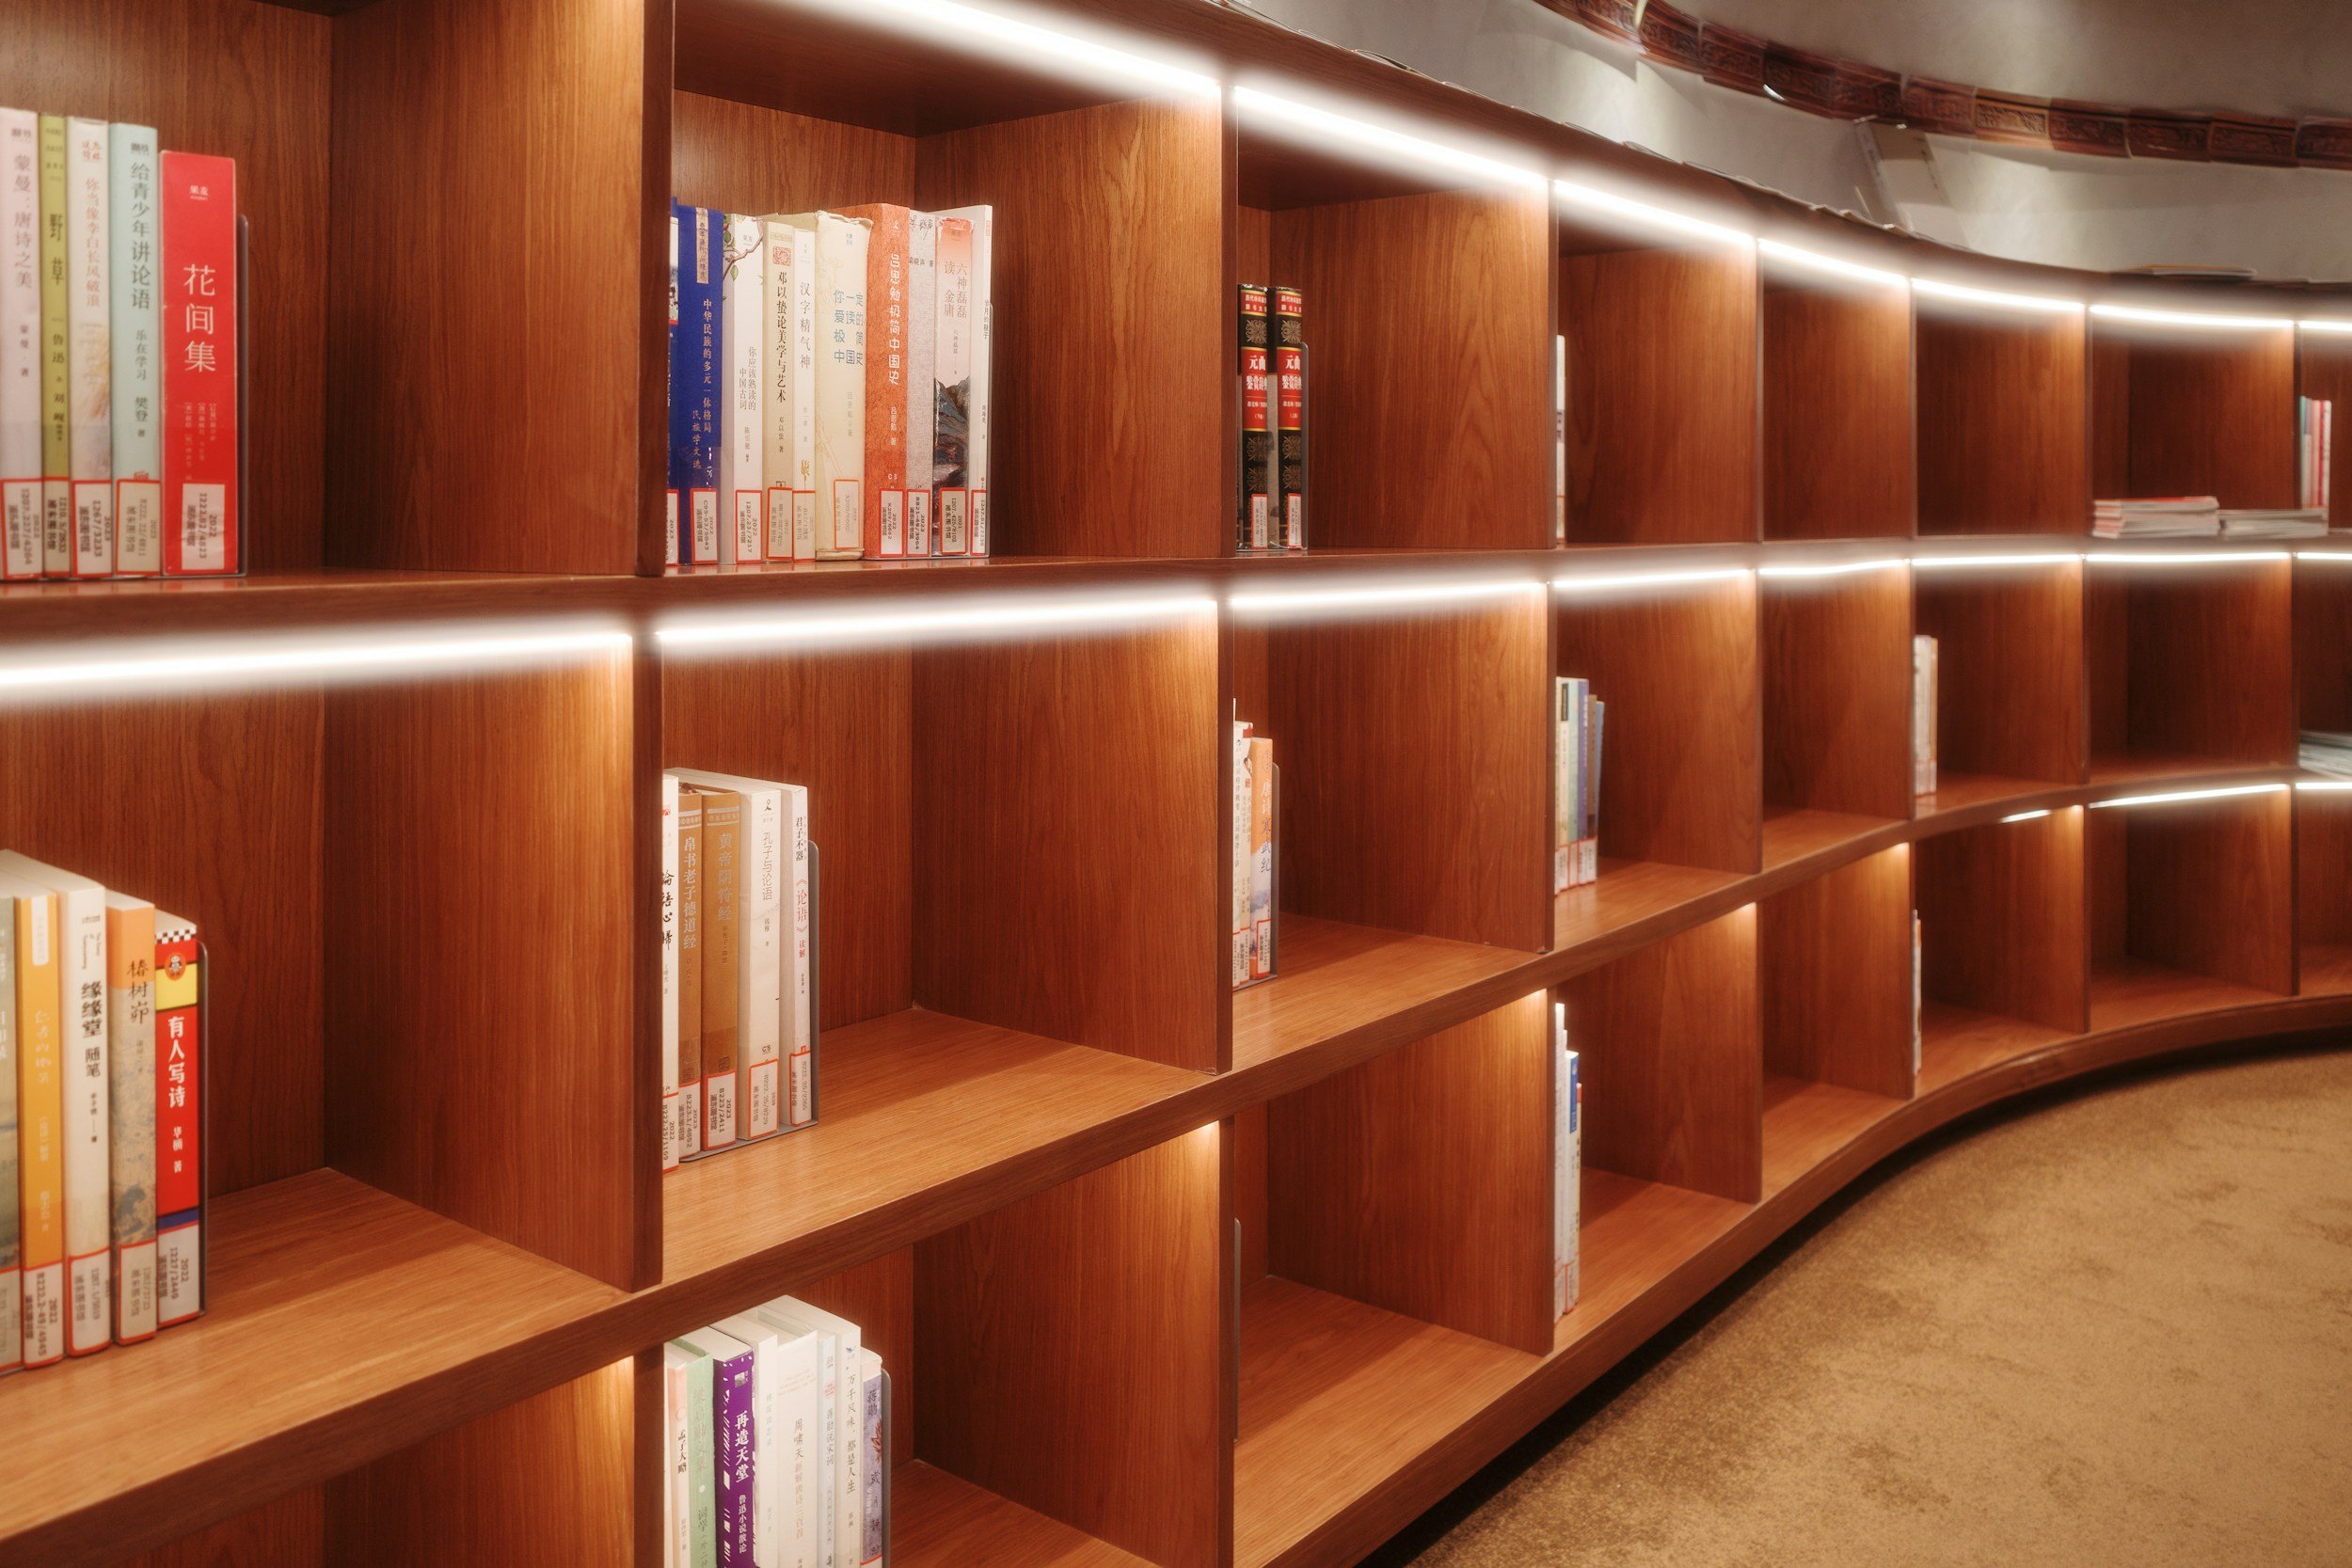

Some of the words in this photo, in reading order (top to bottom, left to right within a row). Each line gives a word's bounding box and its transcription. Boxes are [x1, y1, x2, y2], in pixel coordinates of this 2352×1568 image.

[50, 214, 64, 286] 野草
[131, 162, 151, 309] 给青少年讲论语
[944, 261, 955, 276] 读
[183, 263, 216, 373] 花间集
[888, 253, 901, 387] 吕思勉极简中国史
[943, 289, 955, 318] 金庸
[957, 263, 968, 319] 六神磊磊
[776, 272, 787, 402] 邓以蛰论美学与艺术
[800, 282, 811, 369] 汉字精气神
[702, 298, 712, 434] 中华民族的多元一体格局
[739, 367, 747, 411] 中国古词
[748, 346, 757, 411] 你应该熟读的
[1249, 355, 1266, 371] 元曲
[1286, 355, 1300, 371] 元曲
[209, 515, 217, 538] 2022
[683, 836, 696, 949] 帛书老子德道经
[718, 832, 733, 922] 黄帝阴符经
[762, 832, 773, 902] 孔子与论语
[81, 980, 103, 1038] 缘缘堂
[85, 1047, 101, 1077] 随笔
[167, 1016, 186, 1108] 有人写诗
[181, 1258, 189, 1283] 2022
[49, 1298, 57, 1324] 2022
[735, 1410, 749, 1483] 再造天堂
